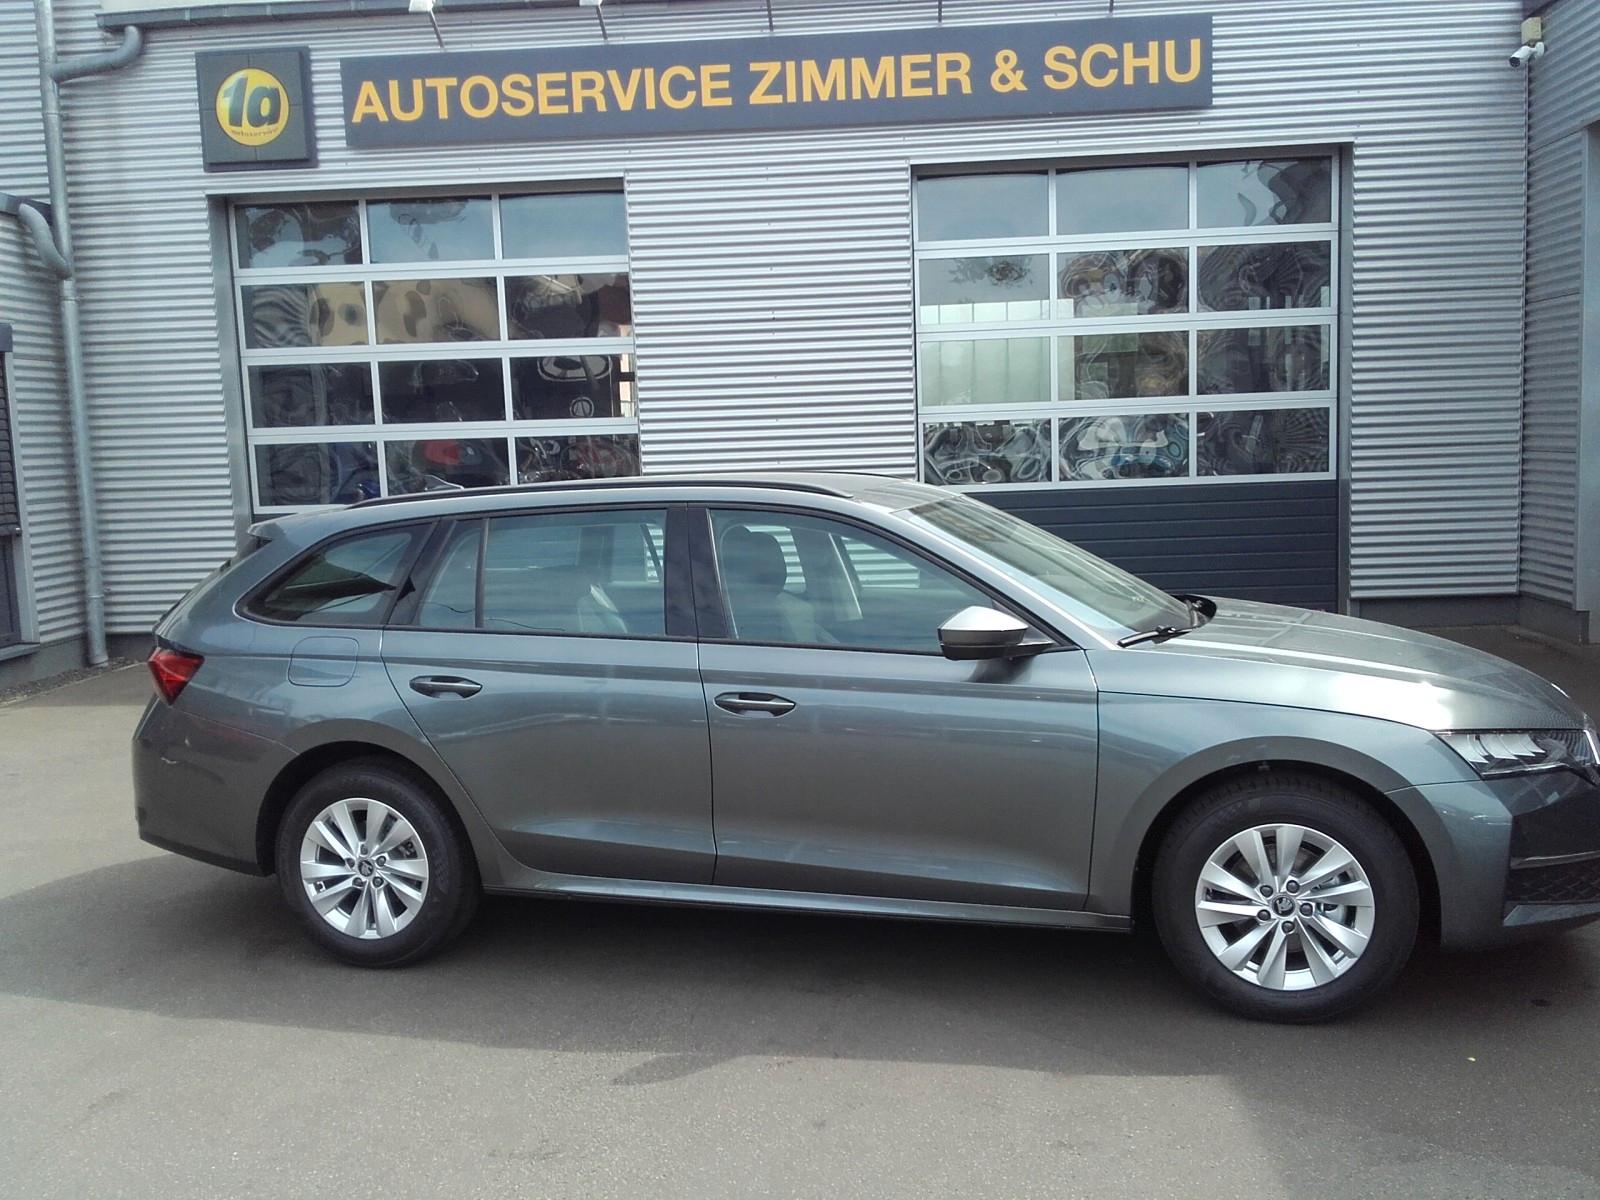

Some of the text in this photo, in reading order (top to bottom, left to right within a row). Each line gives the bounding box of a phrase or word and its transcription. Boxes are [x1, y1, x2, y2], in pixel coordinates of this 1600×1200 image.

[223, 76, 281, 128] 1a
[352, 38, 1201, 123] AUTOSERVICE ZIMMER & SCHU
